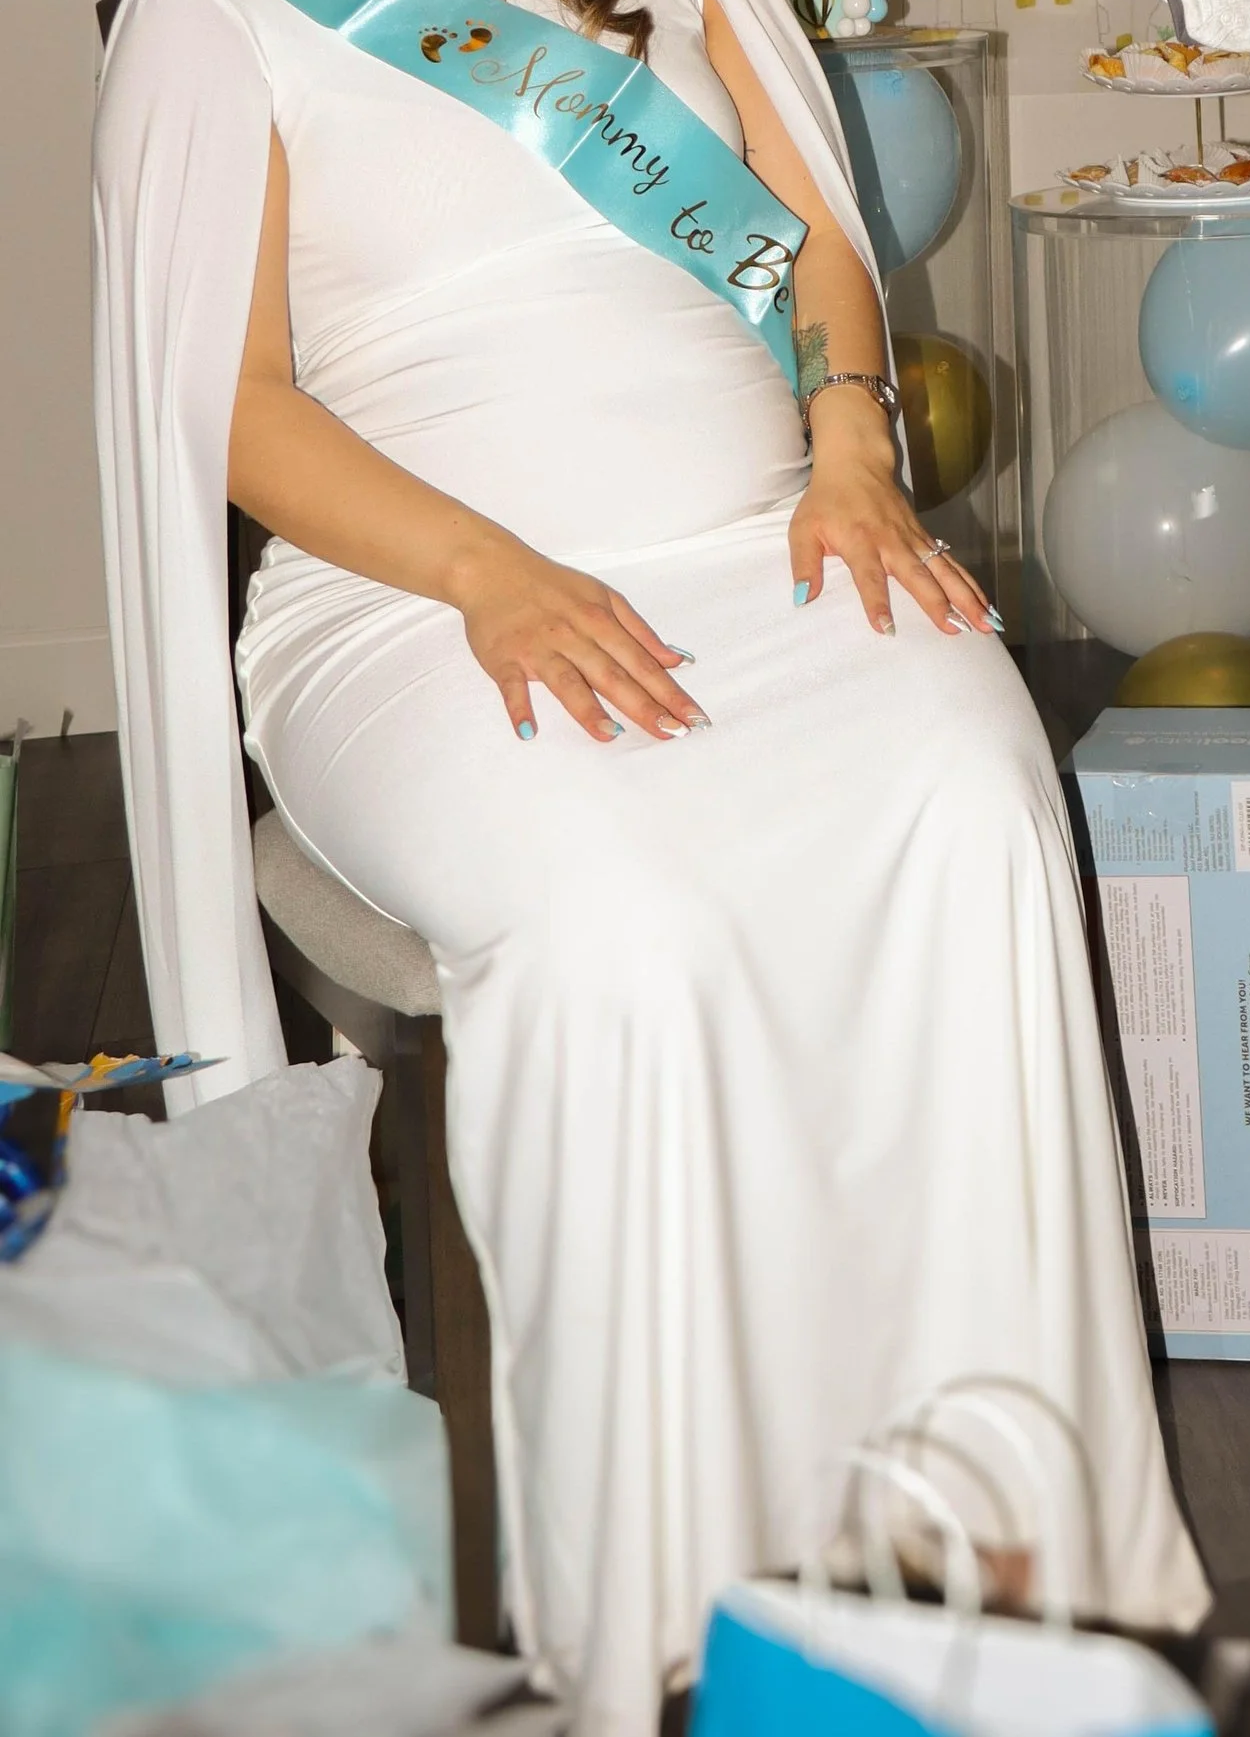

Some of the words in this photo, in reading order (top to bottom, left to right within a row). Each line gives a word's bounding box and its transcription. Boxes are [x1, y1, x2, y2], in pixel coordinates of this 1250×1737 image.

[470, 46, 670, 196] Mommy
[670, 199, 715, 255] to
[727, 233, 790, 314] Be
[1238, 979, 1247, 1004] YOU!
[1239, 1005, 1248, 1033] FROM
[1240, 1036, 1249, 1061] HEAR
[1242, 1063, 1250, 1077] TO
